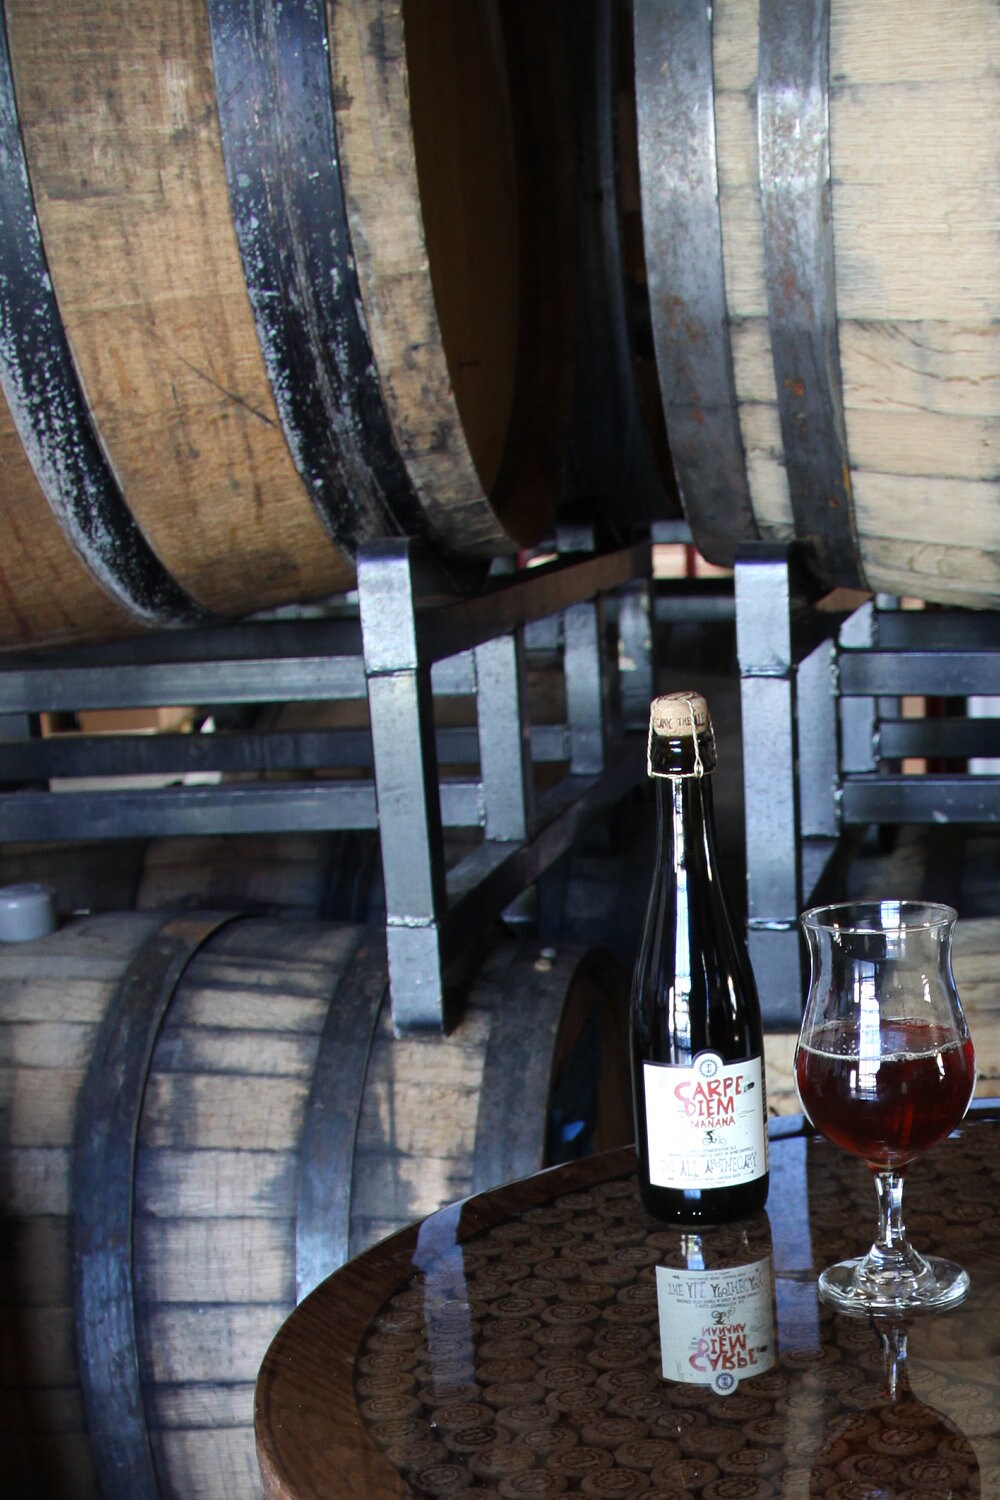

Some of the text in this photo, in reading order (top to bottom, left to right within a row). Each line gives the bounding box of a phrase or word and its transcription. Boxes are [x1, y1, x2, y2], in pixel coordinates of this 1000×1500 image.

[673, 1075, 744, 1102] CARPE
[683, 1096, 735, 1118] DIEM
[680, 1160, 700, 1178] ALE
